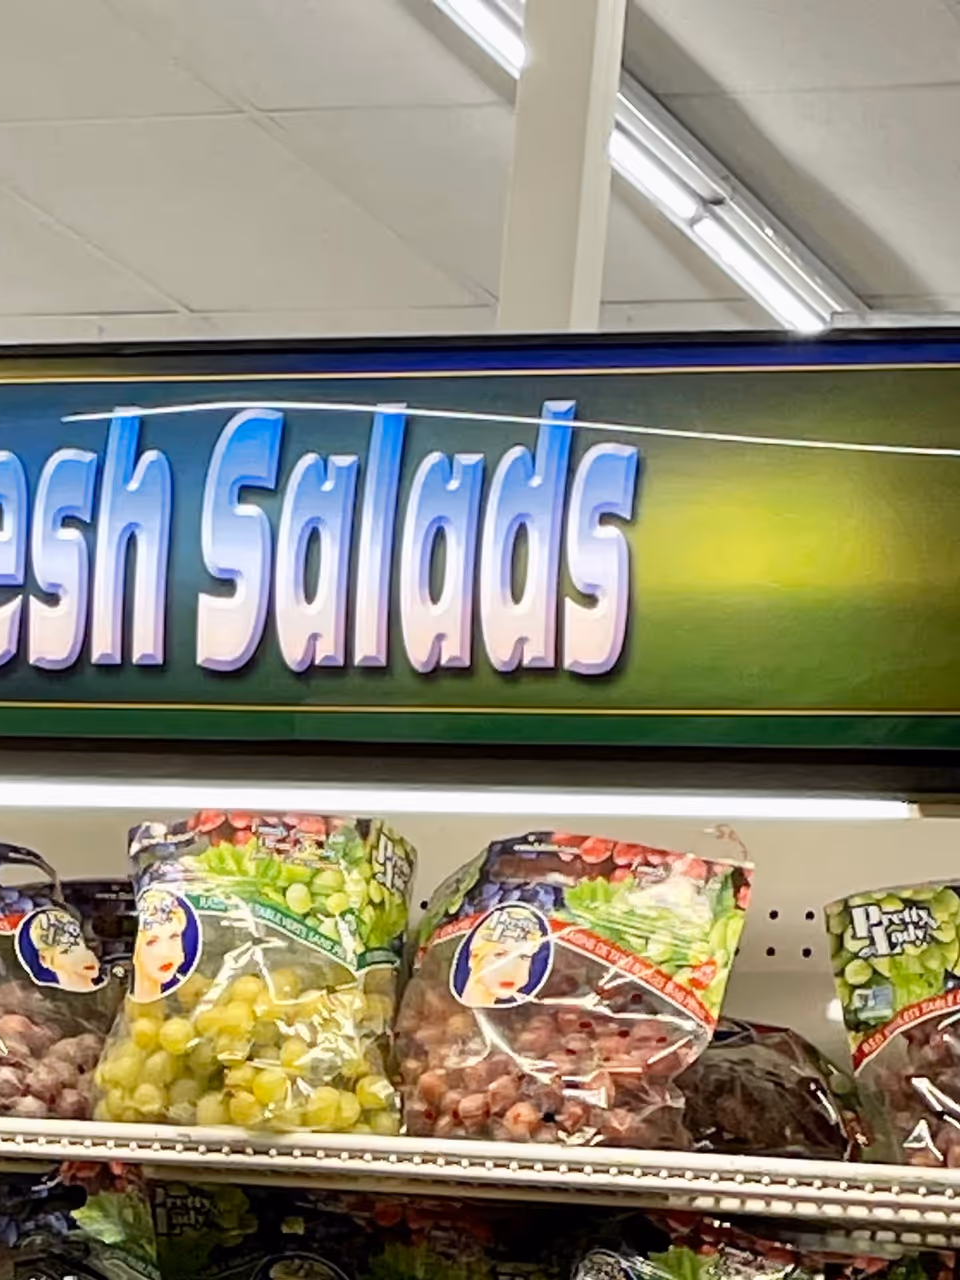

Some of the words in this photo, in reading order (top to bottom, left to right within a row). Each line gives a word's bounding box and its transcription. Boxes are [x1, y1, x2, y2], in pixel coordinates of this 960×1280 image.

[196, 400, 639, 674] Salads
[851, 904, 938, 939] Pretty
[857, 923, 931, 958] Lady
